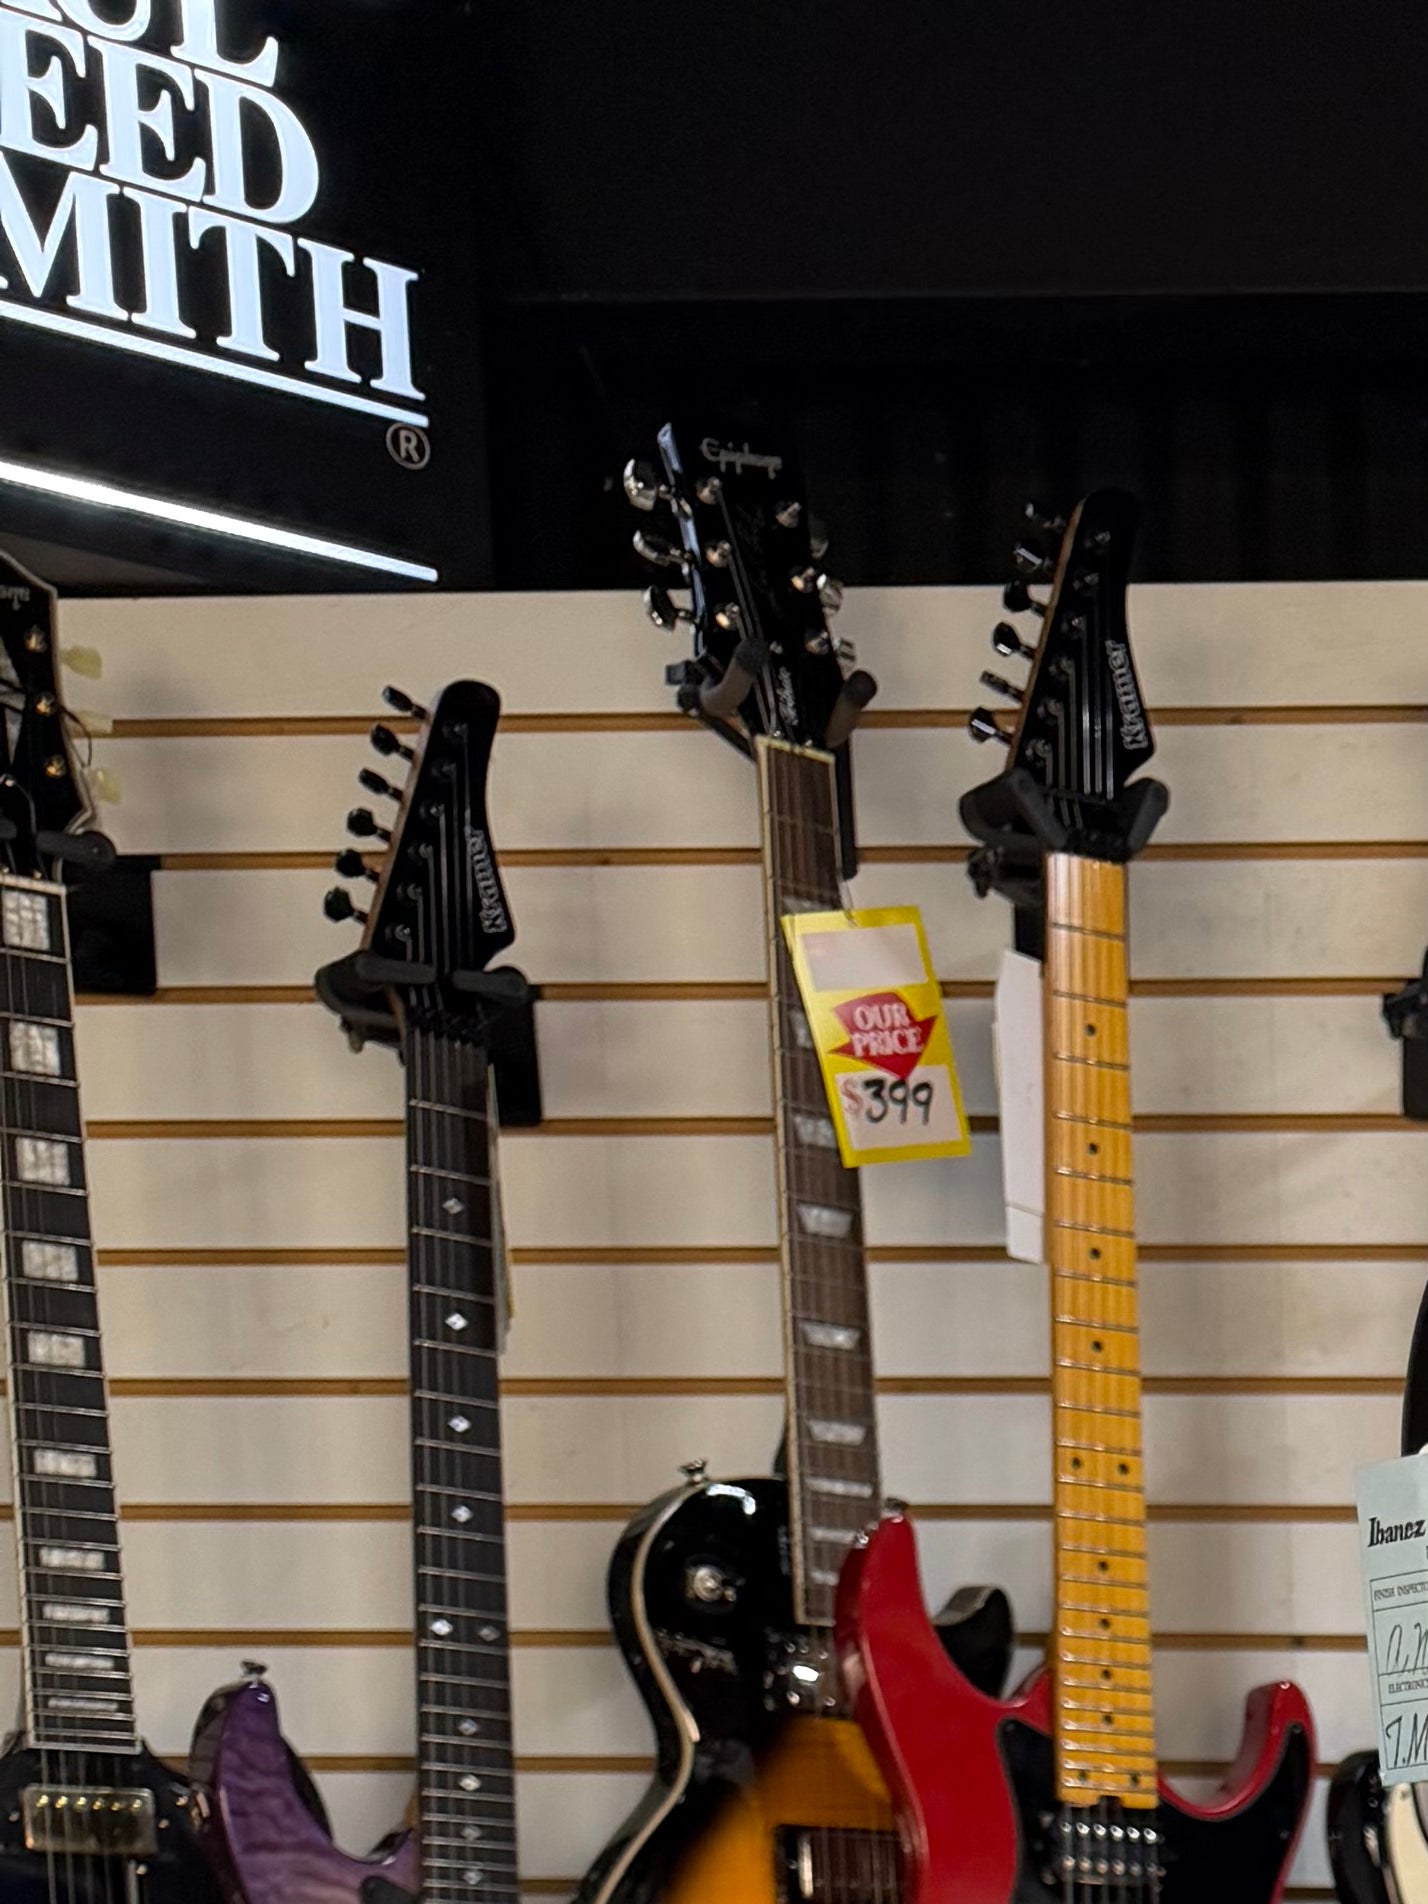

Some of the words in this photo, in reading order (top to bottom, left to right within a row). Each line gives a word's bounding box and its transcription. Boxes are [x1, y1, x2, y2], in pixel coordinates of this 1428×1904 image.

[1105, 639, 1149, 751] Kramer
[468, 829, 509, 935] Kramer
[852, 1002, 912, 1032] OUR
[850, 1026, 926, 1058] PRICE
[841, 1077, 934, 1126] $399
[1367, 1516, 1426, 1547] Ibanez
